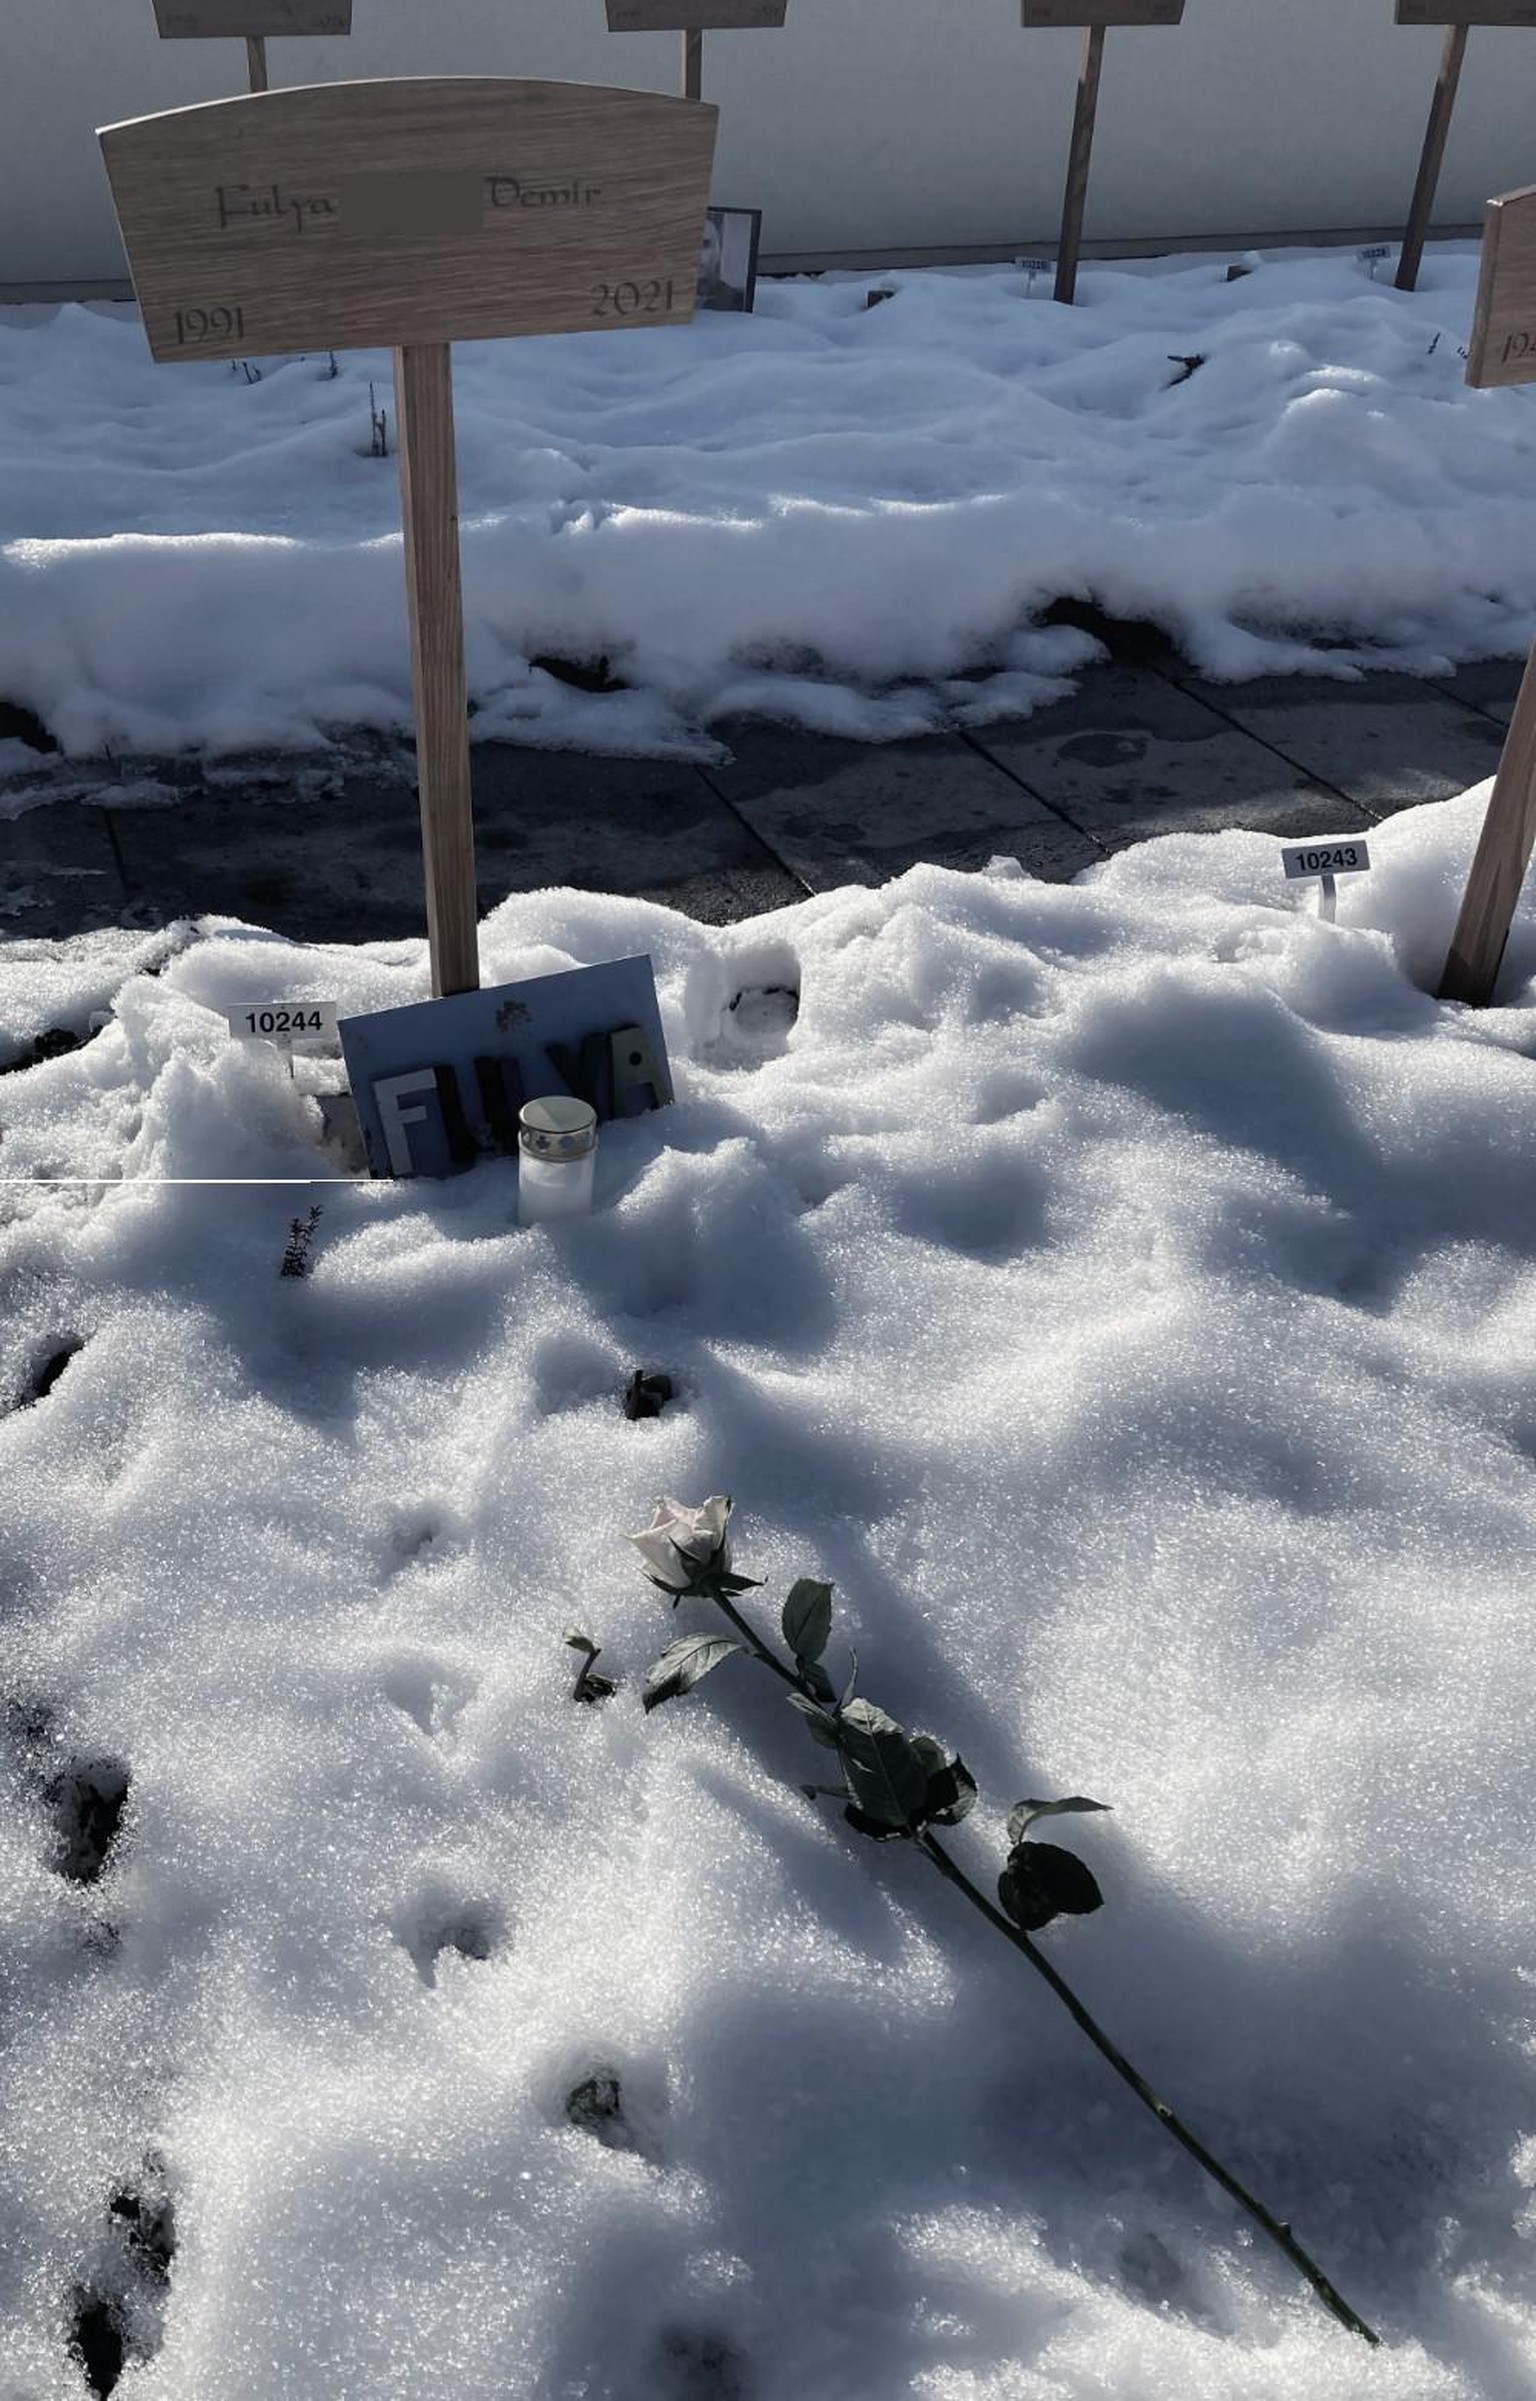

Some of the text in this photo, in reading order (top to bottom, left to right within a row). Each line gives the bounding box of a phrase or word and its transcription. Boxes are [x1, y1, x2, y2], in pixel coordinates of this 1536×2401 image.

[215, 175, 602, 234] Fulya Demir
[590, 279, 674, 316] 2021
[174, 306, 244, 345] 1991
[1296, 847, 1358, 872] 10243
[245, 1010, 323, 1033] 10244
